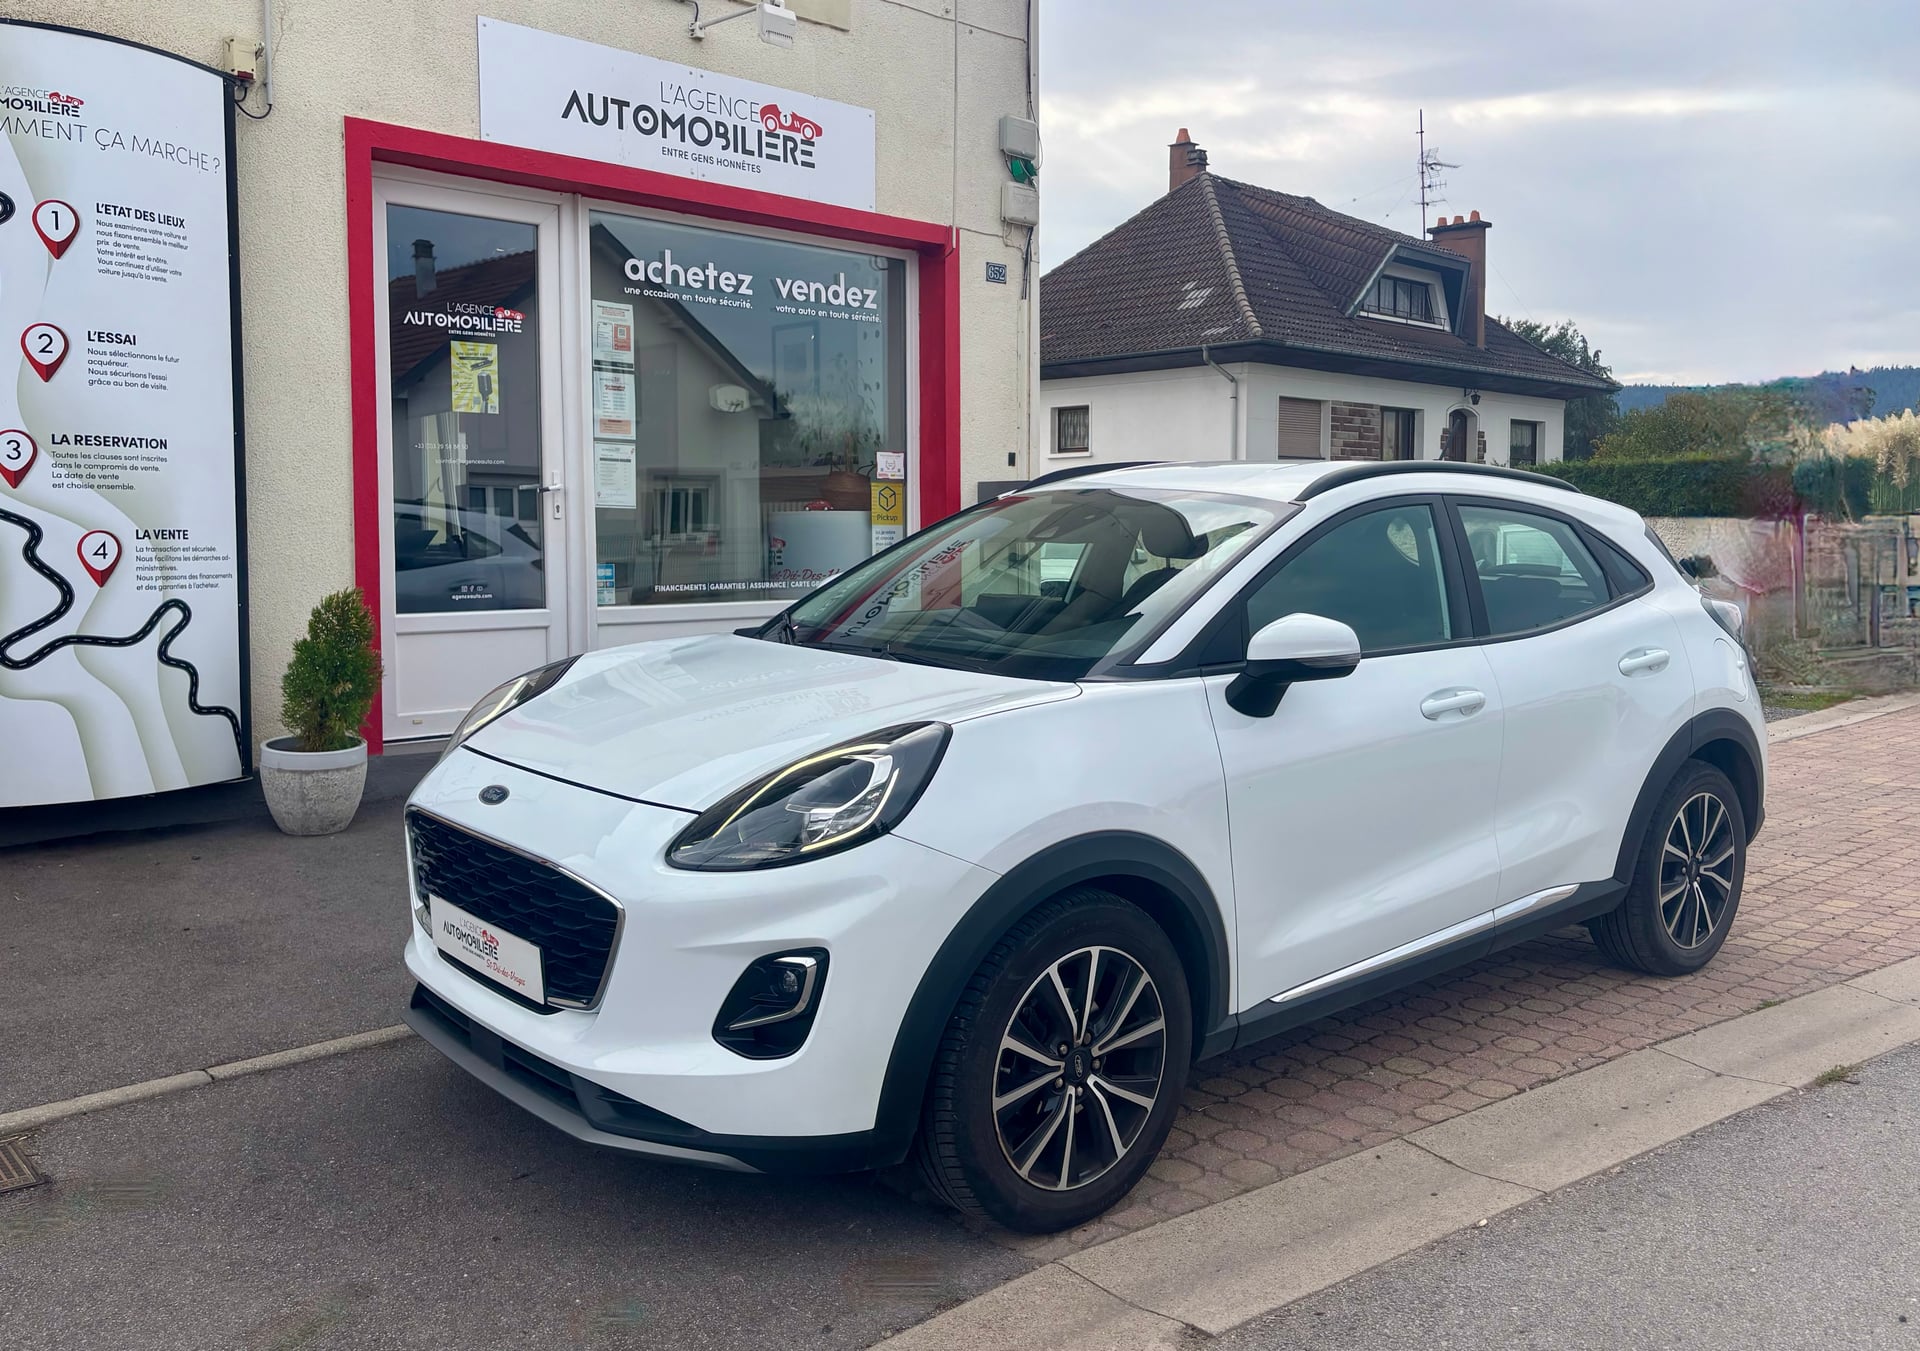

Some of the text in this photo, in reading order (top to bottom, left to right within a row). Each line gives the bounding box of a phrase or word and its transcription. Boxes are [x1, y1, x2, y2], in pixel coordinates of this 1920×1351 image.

[0, 85, 49, 99] 'AGENCE
[660, 80, 760, 124] L'AGENCE
[561, 89, 815, 169] AUTOMOBILIERE
[94, 128, 125, 151] ÇA
[131, 135, 209, 172] MARCHE
[661, 146, 762, 174] ENTRE GENS HONNÊTES
[51, 211, 59, 231] 1
[96, 202, 185, 229] L'ETAT DES LIEUX
[96, 219, 113, 227] Nous
[114, 223, 147, 233] examinons
[164, 231, 181, 240] voiture
[96, 239, 109, 247] prix
[112, 240, 121, 248] de
[114, 231, 132, 240] fixons
[133, 236, 161, 245] ensemble
[168, 241, 188, 250] meilleur
[96, 247, 114, 257] Votre
[116, 250, 136, 259] intérêt
[97, 257, 113, 266] Vous
[114, 261, 144, 270] continuez
[145, 264, 168, 274] d'utiliser
[98, 268, 121, 276] voiture
[121, 270, 144, 280] jusqu'à
[624, 248, 878, 310] achetez vendez
[624, 286, 753, 309] une occasion en toute sécurité.
[447, 302, 495, 316] L'AGENCE
[775, 304, 882, 324] votre auto en toute sérénité.
[403, 311, 522, 333] AUTOMOBILIERE
[38, 333, 54, 354] 2
[87, 330, 137, 346] L'ESSAI
[87, 348, 180, 363] Nous sélectionnons le futur
[87, 358, 129, 368] acquéreur.
[88, 367, 168, 381] Nous sécurisons l'essai
[88, 378, 111, 387] grâce
[124, 380, 139, 388] bon
[140, 381, 150, 389] de
[150, 383, 169, 391] visite.
[51, 433, 168, 450] LA RESERVATION
[6, 439, 22, 460] 3
[51, 451, 79, 459] Toutes
[80, 451, 92, 460] les
[93, 452, 122, 461] clauses
[140, 455, 168, 463] inscrites
[51, 460, 72, 469] dans
[74, 461, 82, 469] le
[83, 463, 128, 472] compromis
[129, 463, 139, 471] de
[52, 471, 62, 479] La
[64, 471, 84, 479] date
[85, 472, 96, 480] de
[66, 481, 95, 490] choisie
[96, 483, 136, 491] ensemble.
[877, 514, 898, 522] Pickup
[135, 529, 189, 540] LA VENTE
[92, 540, 108, 560] 4
[145, 545, 181, 553] transaction
[154, 554, 182, 563] facilitons
[183, 554, 191, 562] les
[136, 564, 178, 572] ministratives.
[136, 574, 153, 582] Nous
[155, 574, 187, 583] proposons
[198, 572, 233, 580] financements
[144, 583, 157, 591] des
[158, 583, 187, 592] garanties
[654, 583, 707, 592] FINANCEMENTS
[709, 582, 746, 590] GARANTIES
[750, 581, 786, 589] ASSURANCE
[791, 580, 810, 588] CARTE
